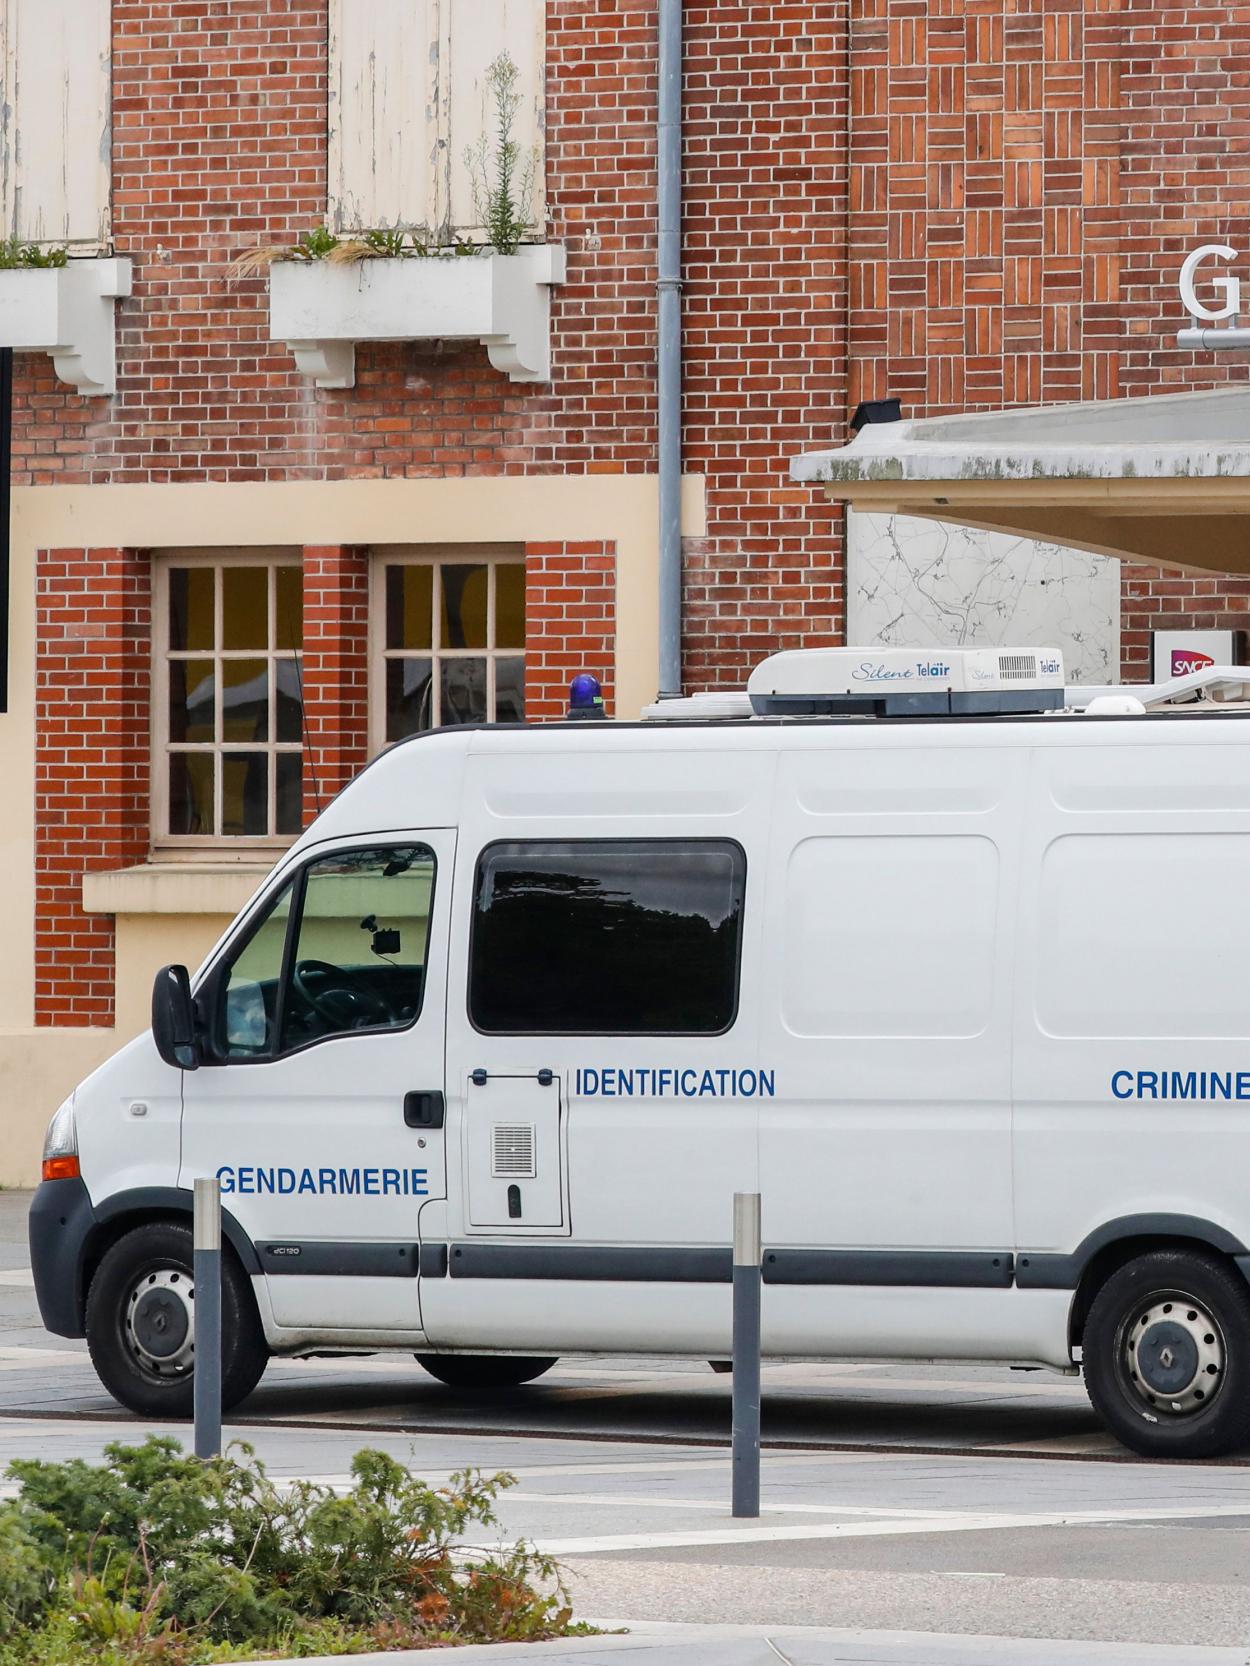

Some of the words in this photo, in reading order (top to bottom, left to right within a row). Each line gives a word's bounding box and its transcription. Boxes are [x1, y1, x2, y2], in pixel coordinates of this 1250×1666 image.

[851, 661, 915, 683] Silent
[575, 1068, 776, 1097] IDENTIFICATION
[215, 1166, 429, 1196] GENDARMERIE
